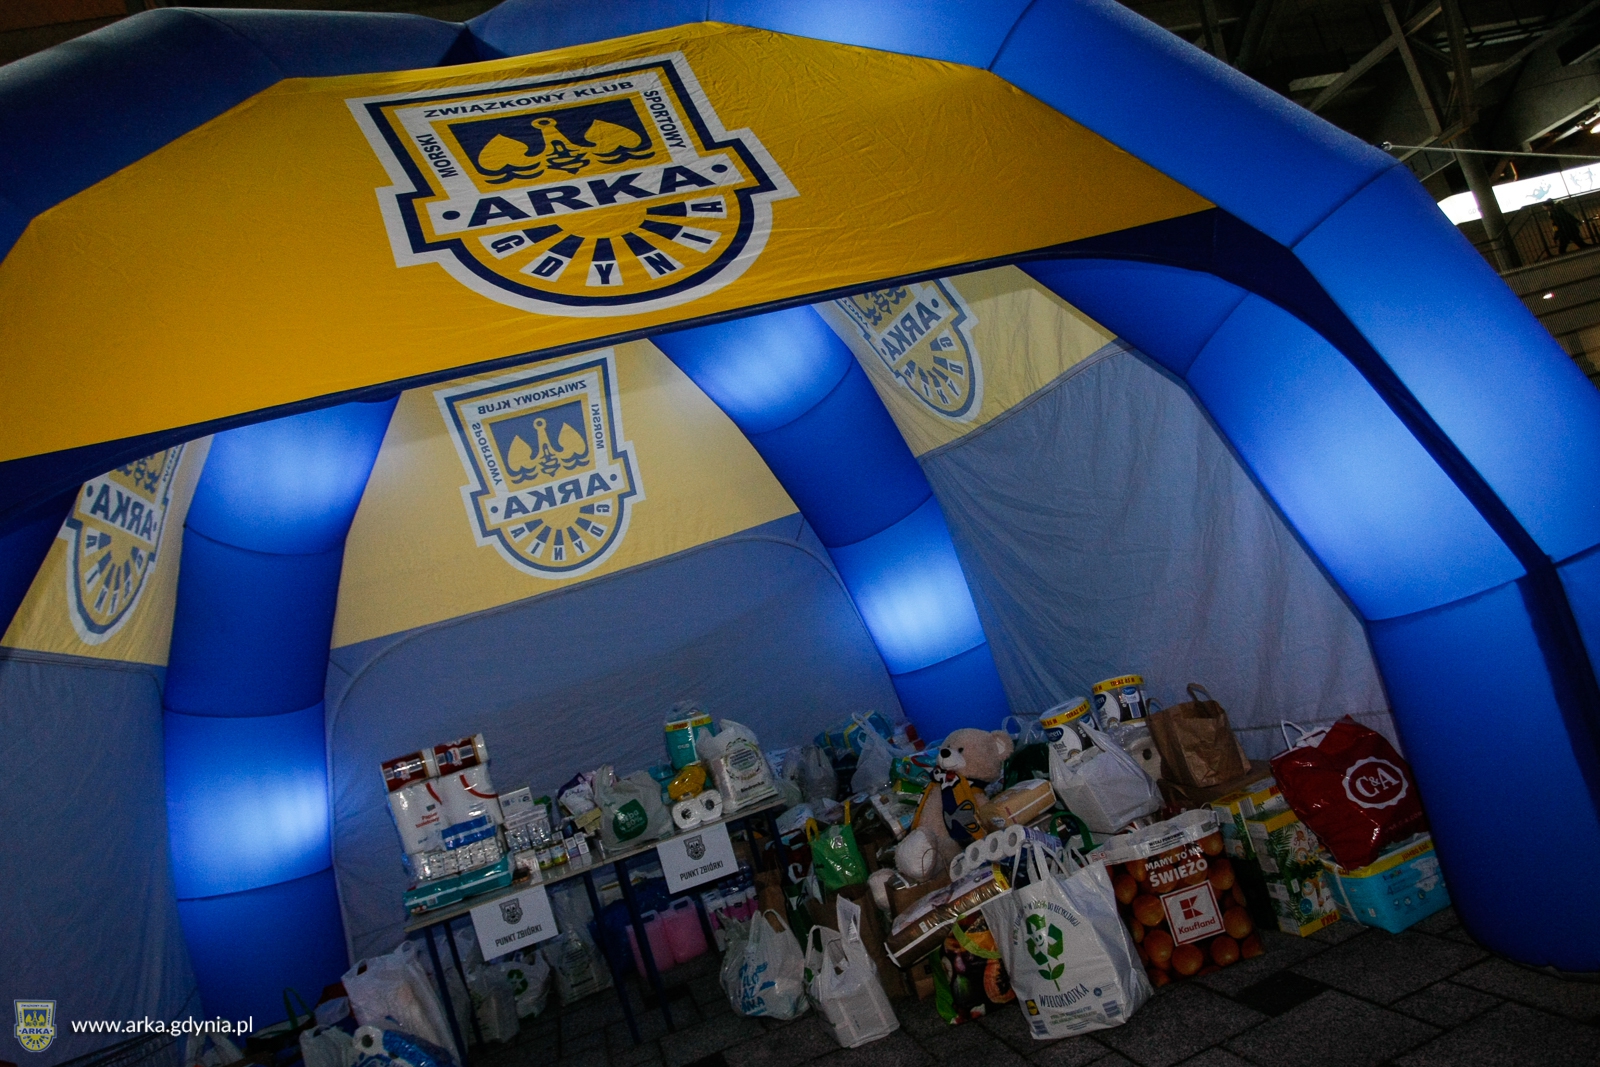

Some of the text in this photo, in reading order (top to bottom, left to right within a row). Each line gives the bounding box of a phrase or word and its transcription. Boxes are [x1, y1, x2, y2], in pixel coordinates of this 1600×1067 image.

[423, 80, 634, 119] ZWIĄZKOWY KLUB
[643, 89, 686, 150] SPORTOWY
[416, 134, 459, 179] MORSKI
[467, 165, 716, 228] ARKA
[490, 201, 723, 286] GDYNIA
[1355, 767, 1400, 798] C&A
[619, 809, 640, 824] orba
[680, 860, 724, 881] PUNKT ZBIÓRKI
[1144, 855, 1174, 872] MAMY
[1174, 851, 1188, 862] TO
[1149, 858, 1208, 888] ŚWIEŻO
[495, 924, 543, 947] PUNKT ZBIÓRKI
[1178, 917, 1216, 935] Kaufland
[1038, 982, 1090, 1008] WIELOKROTKA
